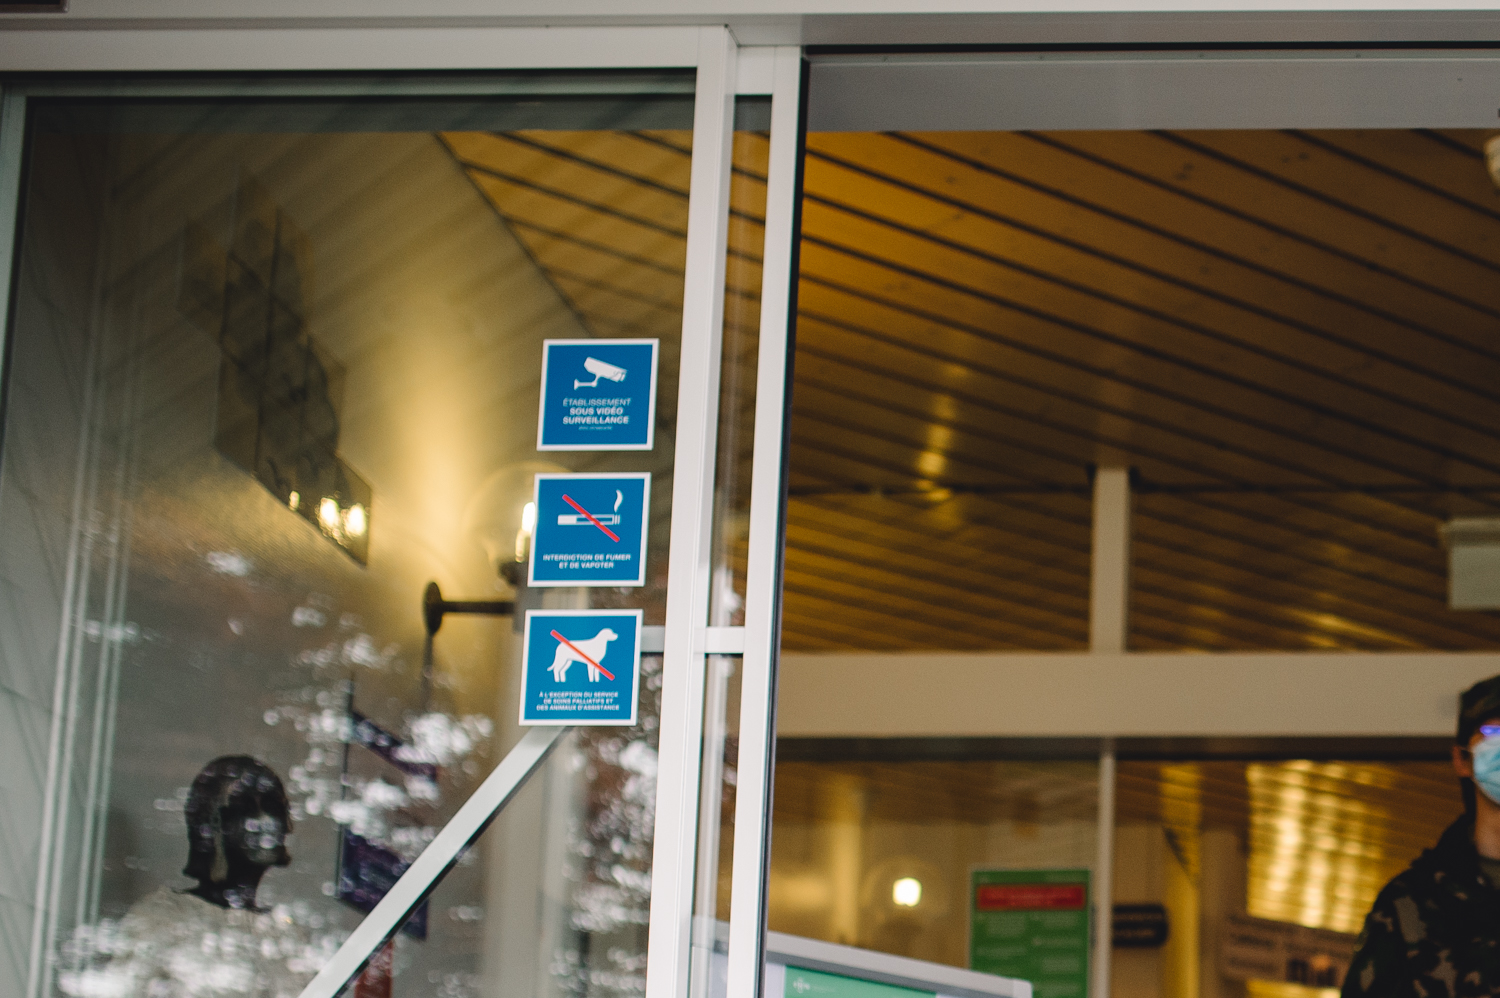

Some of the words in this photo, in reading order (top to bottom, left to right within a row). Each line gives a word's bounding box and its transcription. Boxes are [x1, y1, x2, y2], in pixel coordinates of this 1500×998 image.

[563, 397, 631, 407] ÉTABLISSEMENT
[570, 407, 594, 415] SOUS
[597, 406, 623, 415] VIDÉO
[563, 416, 629, 424] SURVEILLANCE
